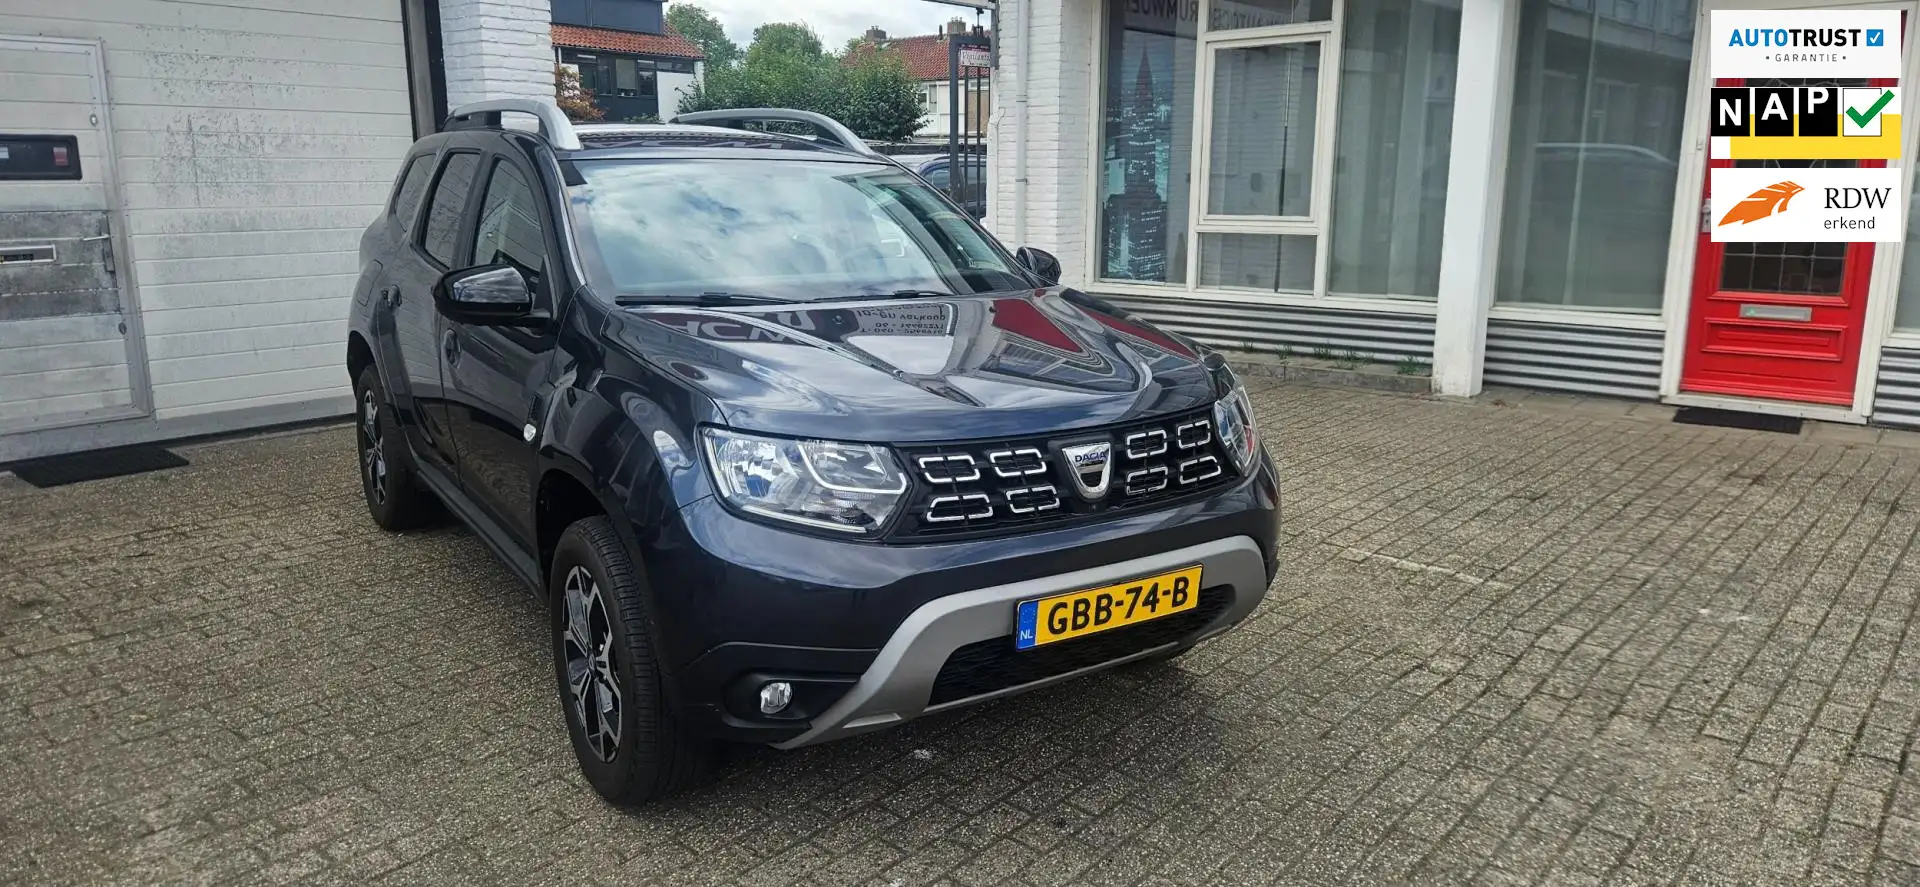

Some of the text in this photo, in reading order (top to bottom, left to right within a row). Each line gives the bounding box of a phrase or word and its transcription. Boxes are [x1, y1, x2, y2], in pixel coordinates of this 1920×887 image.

[1074, 451, 1107, 463] DACIA
[1020, 576, 1190, 641] NL GBB-74-B
